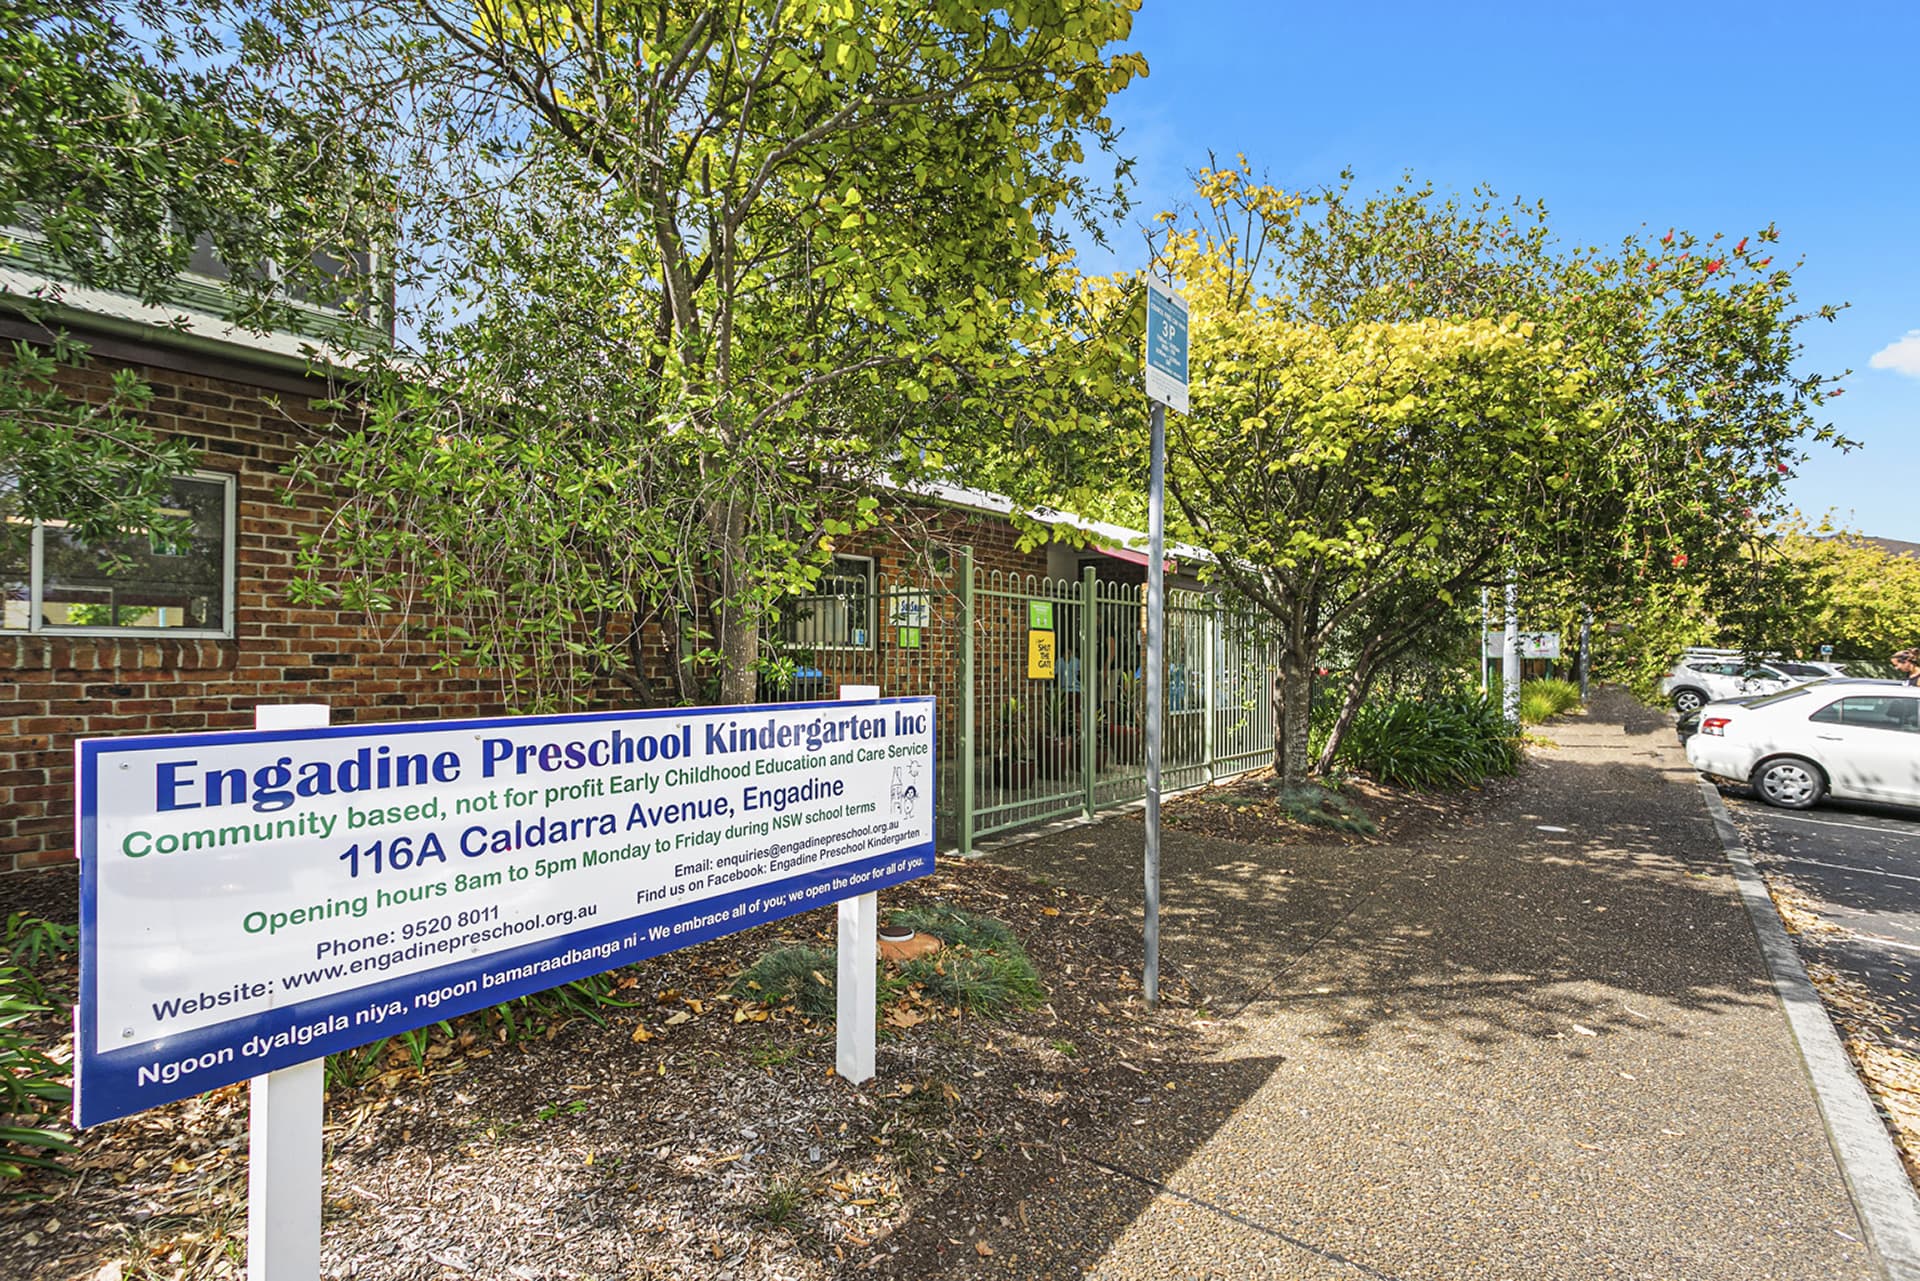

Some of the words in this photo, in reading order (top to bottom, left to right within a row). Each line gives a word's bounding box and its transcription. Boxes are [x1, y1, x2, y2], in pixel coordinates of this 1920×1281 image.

[1162, 319, 1176, 340] 3P
[122, 811, 338, 858] Community
[348, 797, 447, 830] based,
[456, 789, 498, 815] not
[504, 788, 539, 808] for
[545, 778, 604, 808] profit
[610, 772, 660, 794] Early
[665, 762, 751, 788] Childhood
[755, 754, 826, 775] Education
[830, 750, 854, 766] and
[857, 748, 885, 761] Care
[888, 742, 928, 759] Service
[156, 745, 461, 813] Engadine
[482, 725, 691, 778] Preschool
[705, 715, 886, 755] Kindergarten
[895, 710, 927, 736] Inc
[243, 896, 368, 935] Opening
[377, 881, 447, 908] hours
[455, 871, 501, 893] 8am
[508, 865, 529, 882] to
[535, 857, 577, 879] 5pm
[582, 842, 651, 868] Monday
[655, 838, 671, 853] to
[675, 830, 722, 849] Friday
[725, 821, 769, 840] during
[772, 813, 803, 831] NSW
[805, 805, 843, 824] school
[845, 802, 876, 816] terms
[339, 833, 447, 878] 116A
[460, 812, 617, 858] Caldarra
[626, 796, 735, 831] Avenue,
[743, 778, 844, 811] Engadine
[637, 886, 666, 904] Find
[670, 883, 685, 896] us
[688, 879, 704, 891] on
[707, 864, 767, 887] Facebook:
[769, 852, 817, 872] Engadine
[820, 841, 866, 860] Preschool
[867, 829, 920, 849] Kindergarten
[674, 859, 713, 878] Email:
[716, 821, 899, 868] enquiries@engadinepreschool.org.au
[137, 1047, 233, 1087] Ngoon
[242, 1015, 349, 1057] dyalgala
[356, 1001, 408, 1025] niya,
[414, 980, 477, 1008] ngoon
[482, 941, 620, 988] bamaraadbanga
[623, 932, 637, 949] ni
[647, 926, 671, 942] We
[673, 910, 730, 934] embrace
[732, 902, 746, 918] all
[748, 898, 761, 913] of
[763, 895, 787, 912] you;
[788, 889, 804, 901] we
[805, 882, 831, 898] open
[832, 878, 848, 890] the
[849, 871, 870, 885] door
[872, 867, 885, 878] for
[886, 862, 896, 875] all
[897, 859, 907, 872] of
[907, 858, 924, 871] you.
[151, 981, 274, 1022] Website:
[281, 904, 597, 989] www.engadinepreschool.org.au
[317, 930, 395, 960] Phone:
[402, 915, 451, 940] 9520
[457, 905, 499, 927] 8011
